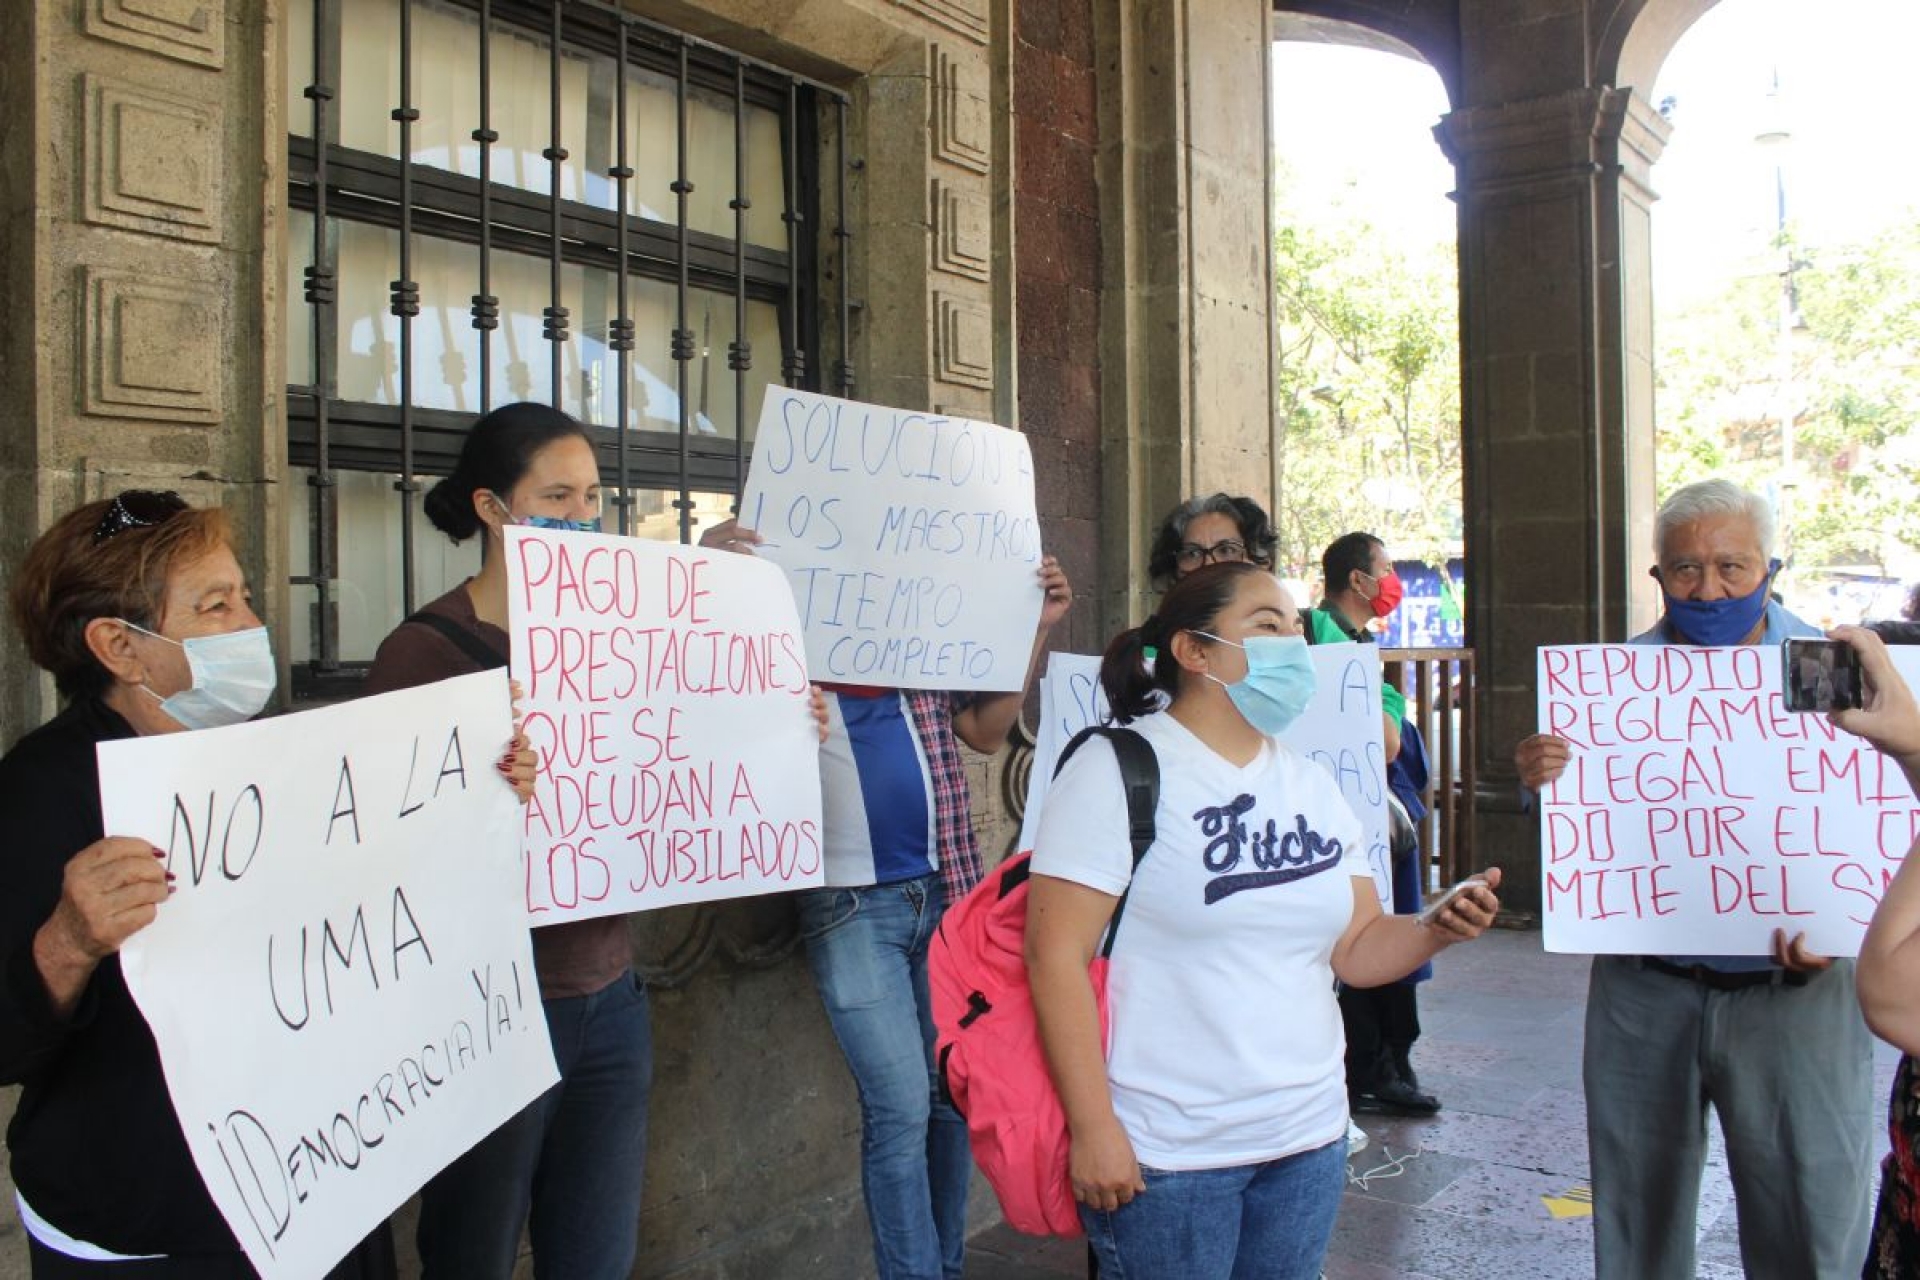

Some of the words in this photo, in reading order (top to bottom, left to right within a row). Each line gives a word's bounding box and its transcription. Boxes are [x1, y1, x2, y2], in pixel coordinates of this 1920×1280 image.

[768, 397, 1001, 487] SOLUCIÓN
[753, 491, 843, 550] LOS
[876, 505, 1037, 563] MAESTROS
[518, 537, 639, 619] PAGO
[667, 555, 710, 623] DE
[793, 566, 962, 631] TIEMPO
[527, 625, 807, 703] PRESTACIONES
[828, 635, 994, 679] COMPLETO
[1340, 659, 1372, 717] A
[1543, 647, 1762, 697] REPUDIO
[520, 710, 617, 784] QUE
[632, 706, 690, 769] SE
[167, 783, 263, 888] NO
[326, 755, 361, 845] A
[398, 726, 466, 818] LA
[526, 760, 713, 840] ADEUDAN
[729, 762, 760, 816] A
[1193, 793, 1343, 874] Fitch
[1548, 808, 1615, 865] DO
[1648, 805, 1750, 861] POR
[1775, 805, 1849, 857] EL
[526, 836, 610, 912] LOS
[627, 820, 820, 892] JUBILADOS
[1546, 865, 1681, 920] MITE
[1712, 864, 1816, 916] DEL
[269, 885, 433, 1030] UMA
